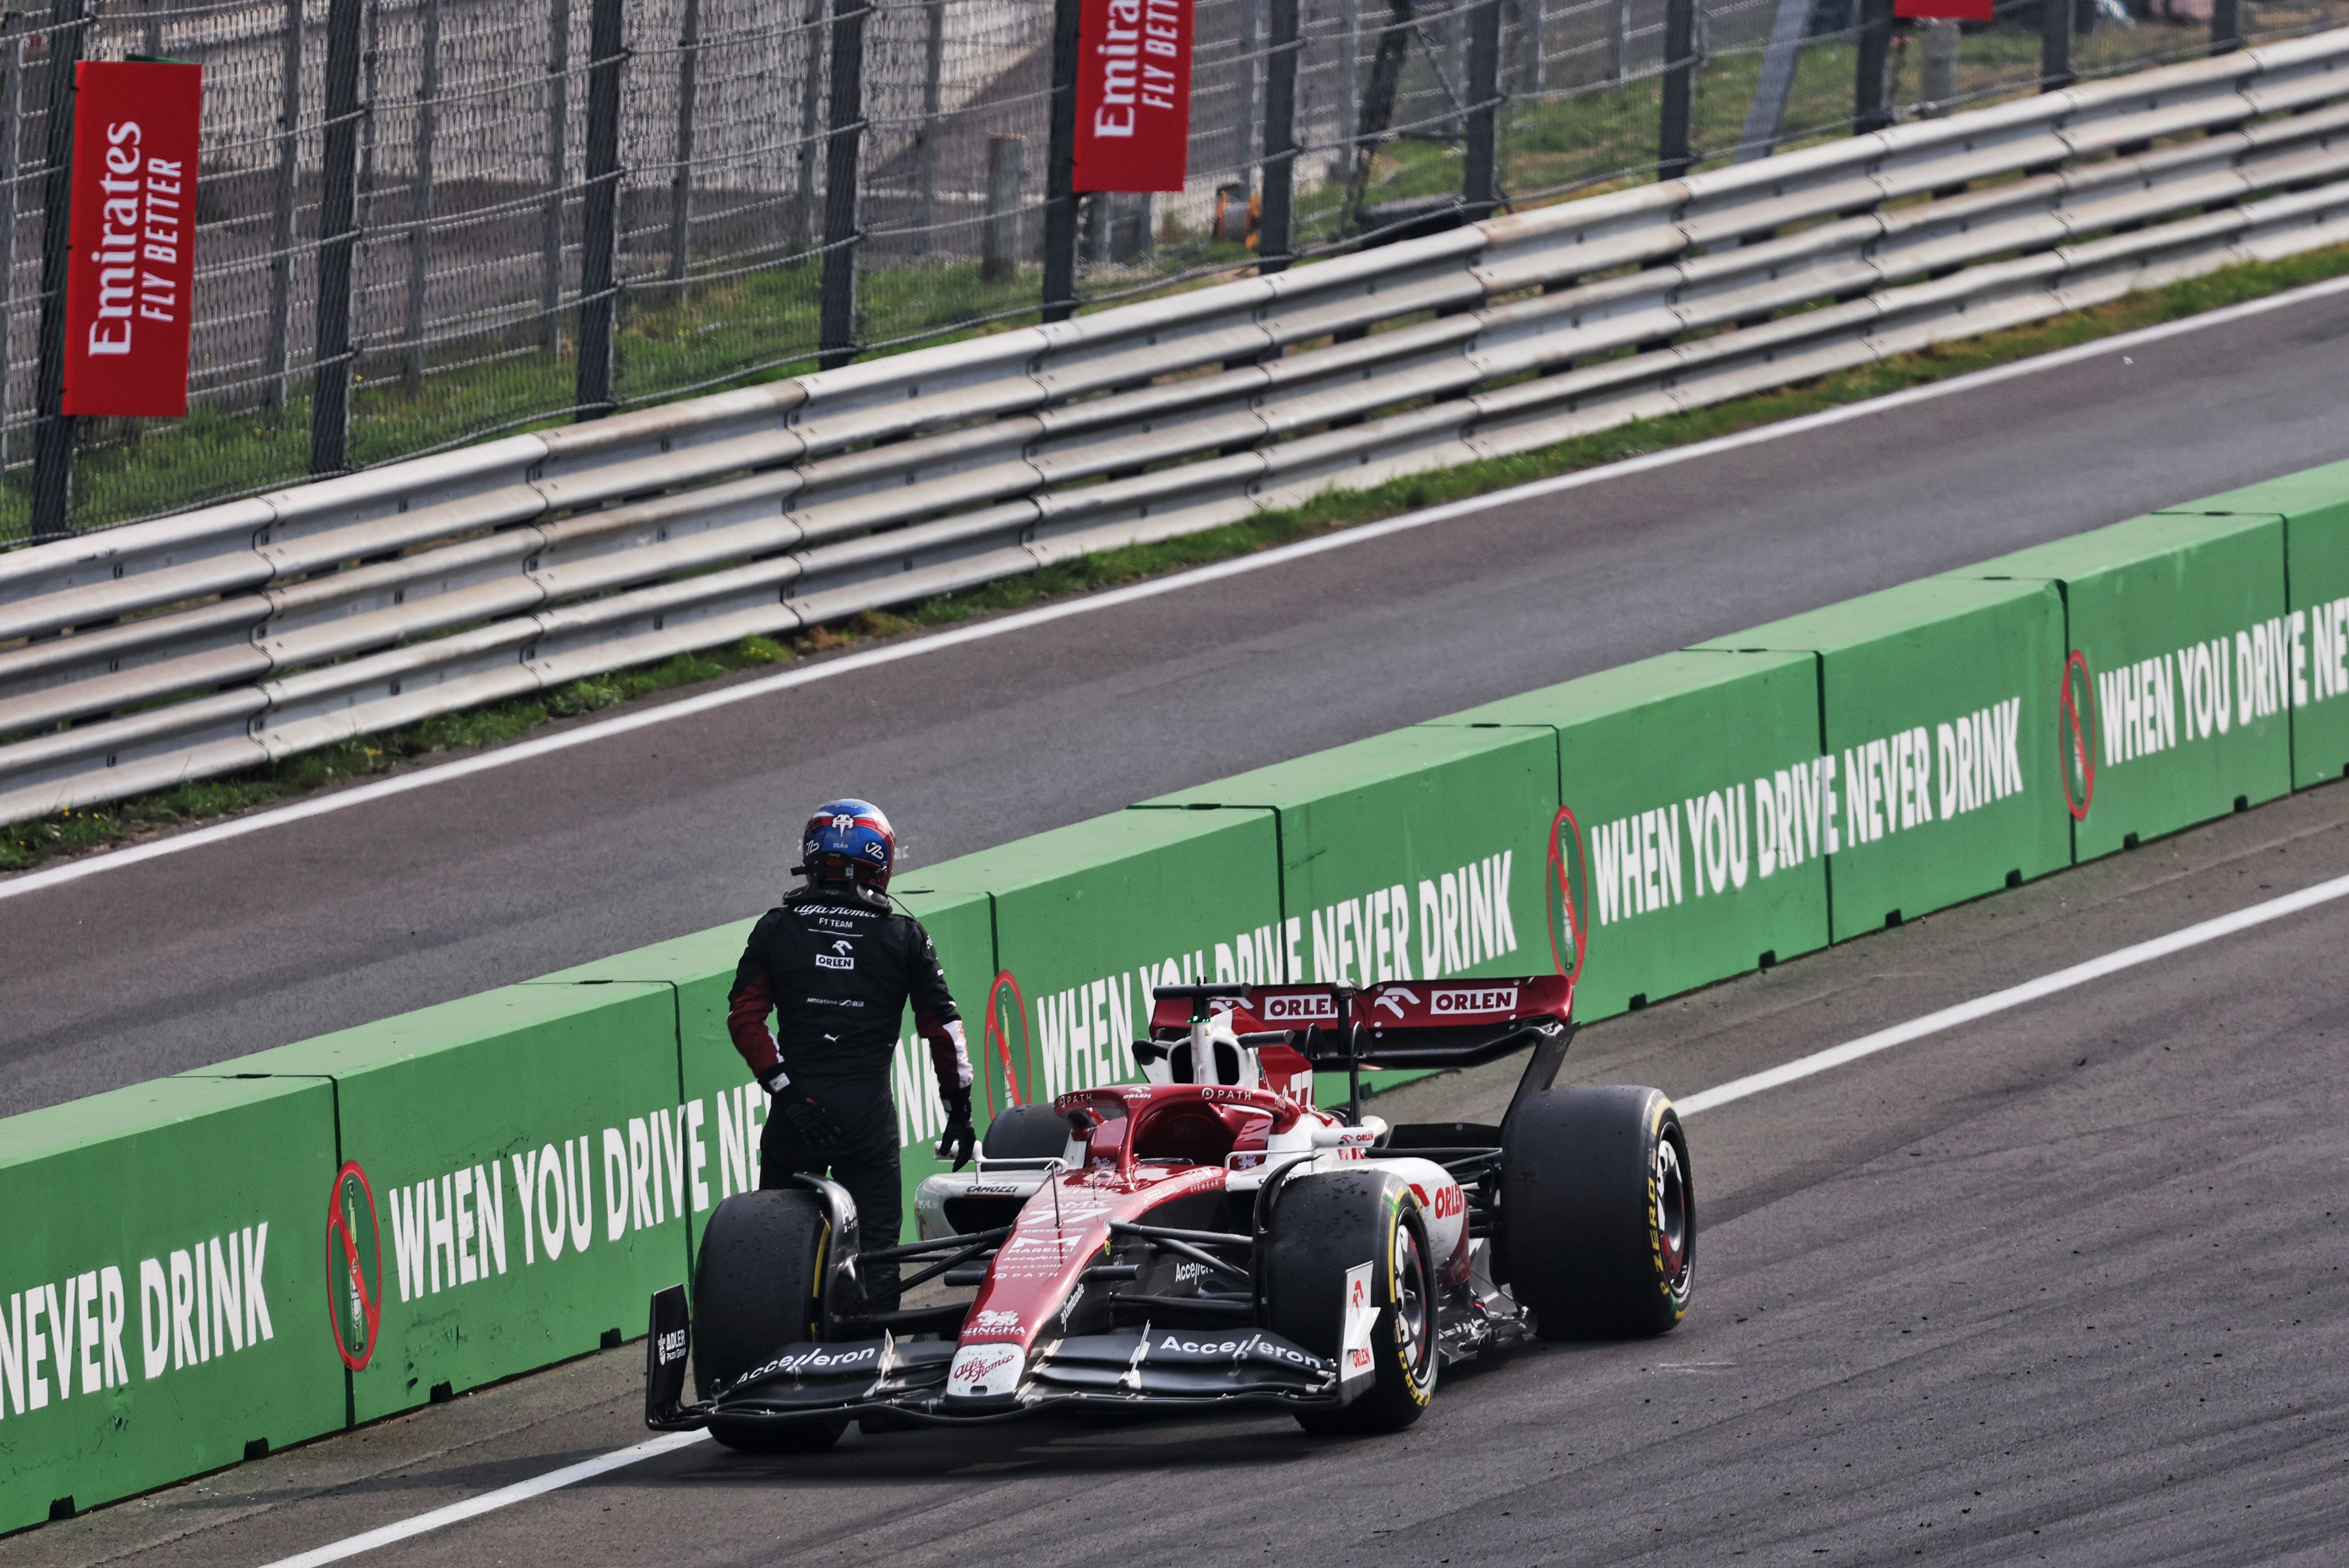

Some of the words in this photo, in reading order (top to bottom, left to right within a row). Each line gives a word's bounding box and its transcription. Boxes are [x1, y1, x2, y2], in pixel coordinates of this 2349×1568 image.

[1143, 64, 1174, 109] FLY
[144, 158, 182, 264] BETTER
[88, 121, 141, 357] Emirates
[141, 271, 175, 322] FLY
[2098, 653, 2175, 767] WHEN
[2177, 637, 2230, 739] YOU
[2236, 610, 2307, 726] DRIVE
[1592, 804, 1682, 926] WHEN
[1685, 783, 1747, 897] YOU
[1755, 754, 1839, 879] DRIVE
[1844, 727, 1933, 847] NEVER
[1937, 696, 2023, 820] DRINK
[830, 919, 853, 928] TEAM
[1312, 884, 1413, 991] NEVER
[1418, 850, 1517, 979] DRINK
[818, 956, 851, 967] ORLEN
[1435, 991, 1512, 1011] ORLEN
[1037, 972, 1135, 1104] WHEN
[1067, 1093, 1092, 1104] PATH
[1217, 1090, 1252, 1100] PATH
[389, 1160, 507, 1303] WHEN
[511, 1135, 593, 1265] YOU
[603, 1099, 709, 1242] DRIVE
[966, 1185, 1019, 1193] CAMOZZI
[1191, 1180, 1219, 1192] EYEWEAR
[1018, 1208, 1113, 1225] 77
[1648, 1177, 1665, 1273] ZERO
[0, 1266, 129, 1420] NEVER
[140, 1221, 274, 1380] DRINK
[963, 1326, 1026, 1334] SINGHA
[666, 1329, 685, 1351] ADLER
[1160, 1334, 1321, 1369] Accelleron
[954, 1357, 988, 1381] Alfa
[971, 1354, 1015, 1383] Romeo
[1352, 1347, 1370, 1368] ORLEN
